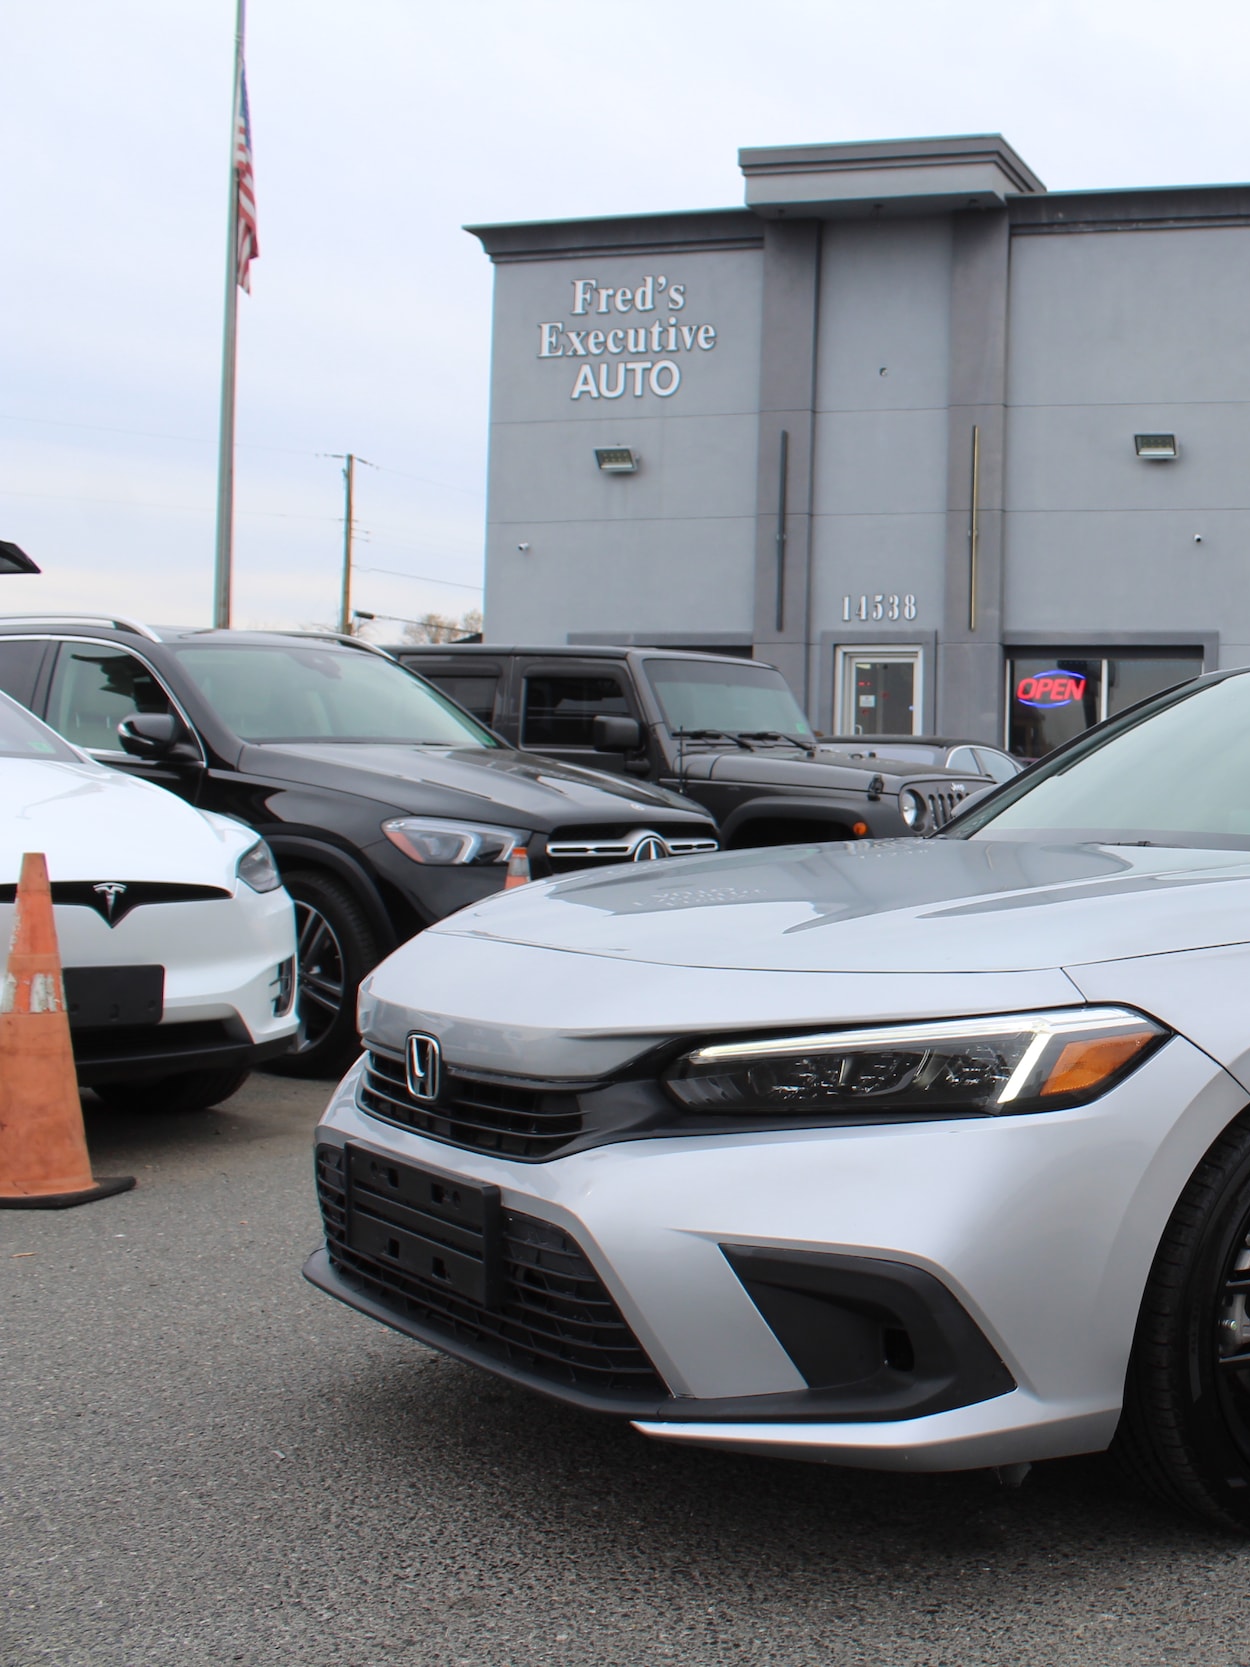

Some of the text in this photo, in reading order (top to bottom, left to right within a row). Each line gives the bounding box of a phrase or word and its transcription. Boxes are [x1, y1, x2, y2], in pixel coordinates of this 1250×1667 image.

[571, 276, 686, 315] Fred's
[537, 317, 717, 358] Executive
[570, 360, 682, 400] AUTO
[842, 594, 917, 621] 14538
[1016, 677, 1087, 701] OPEN
